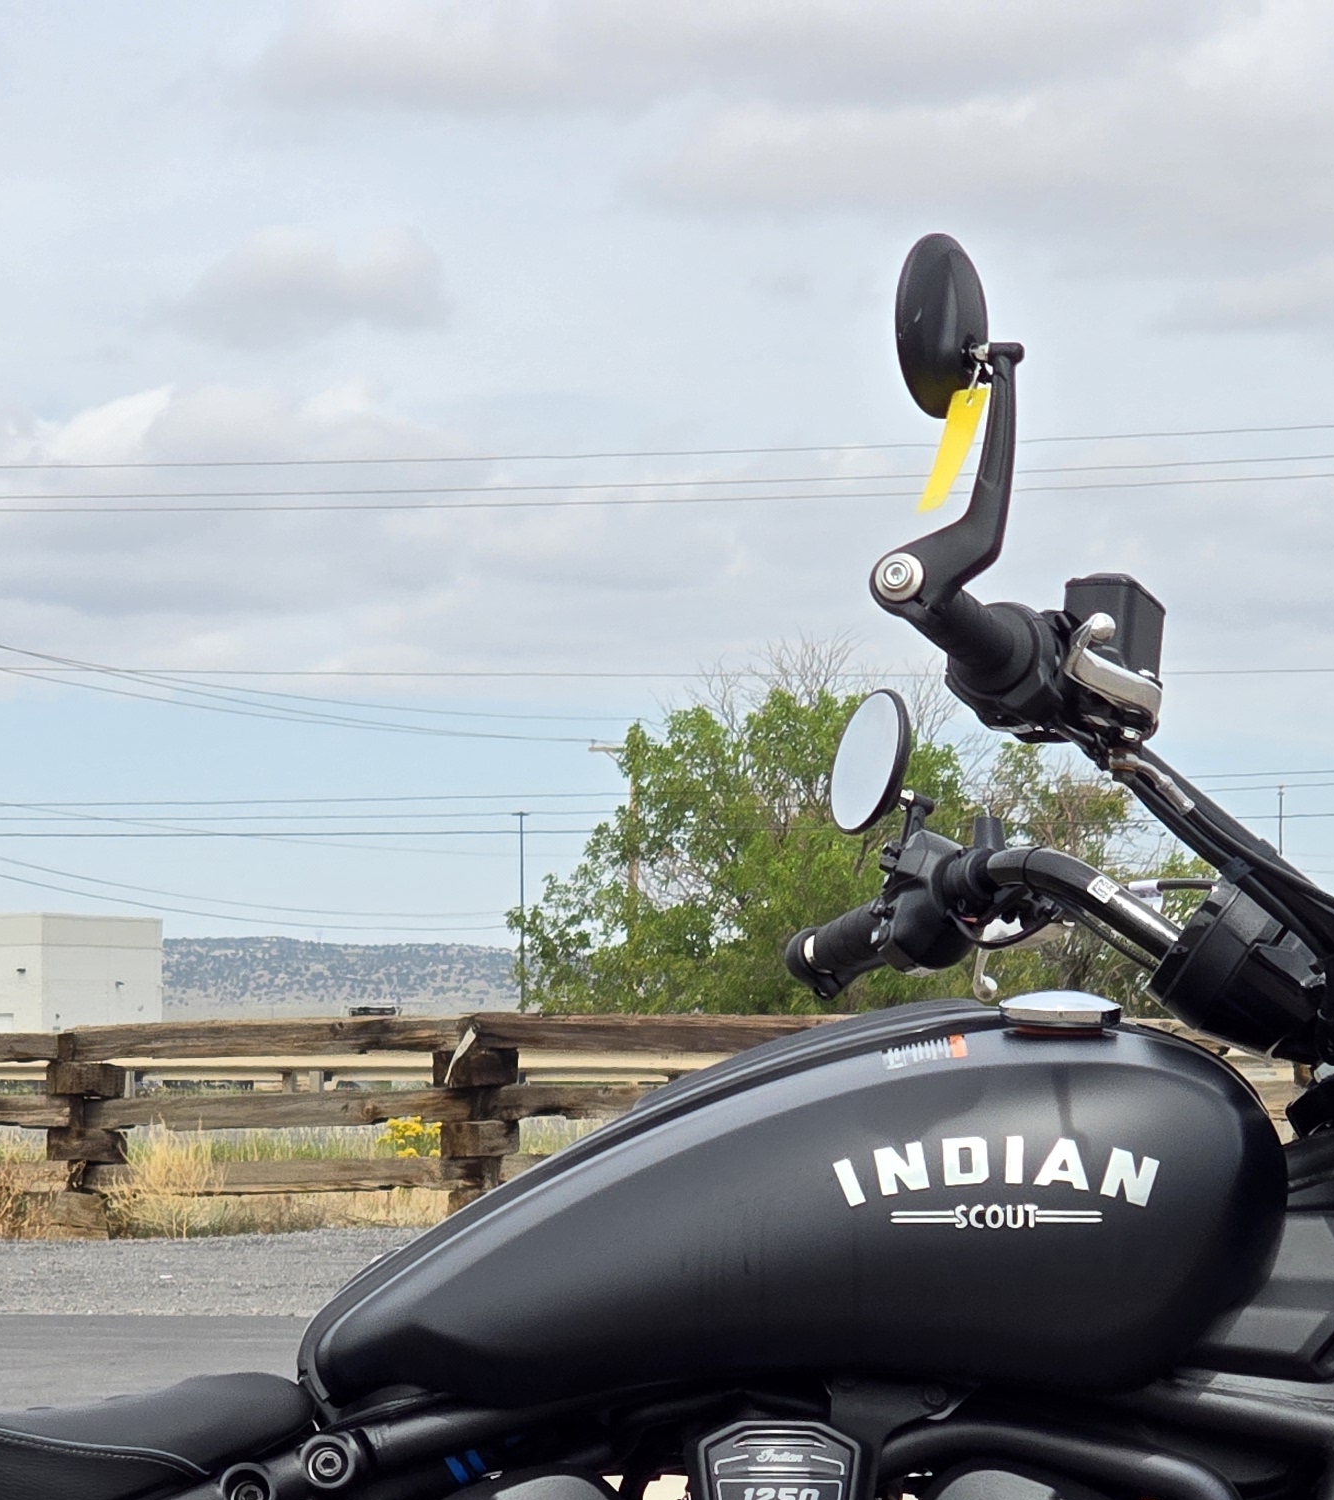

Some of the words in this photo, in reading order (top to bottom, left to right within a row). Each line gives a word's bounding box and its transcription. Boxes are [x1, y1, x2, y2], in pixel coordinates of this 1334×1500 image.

[832, 1135, 1160, 1207] INDIAN
[954, 1204, 1038, 1229] SCOUT
[756, 1448, 804, 1464] Indian
